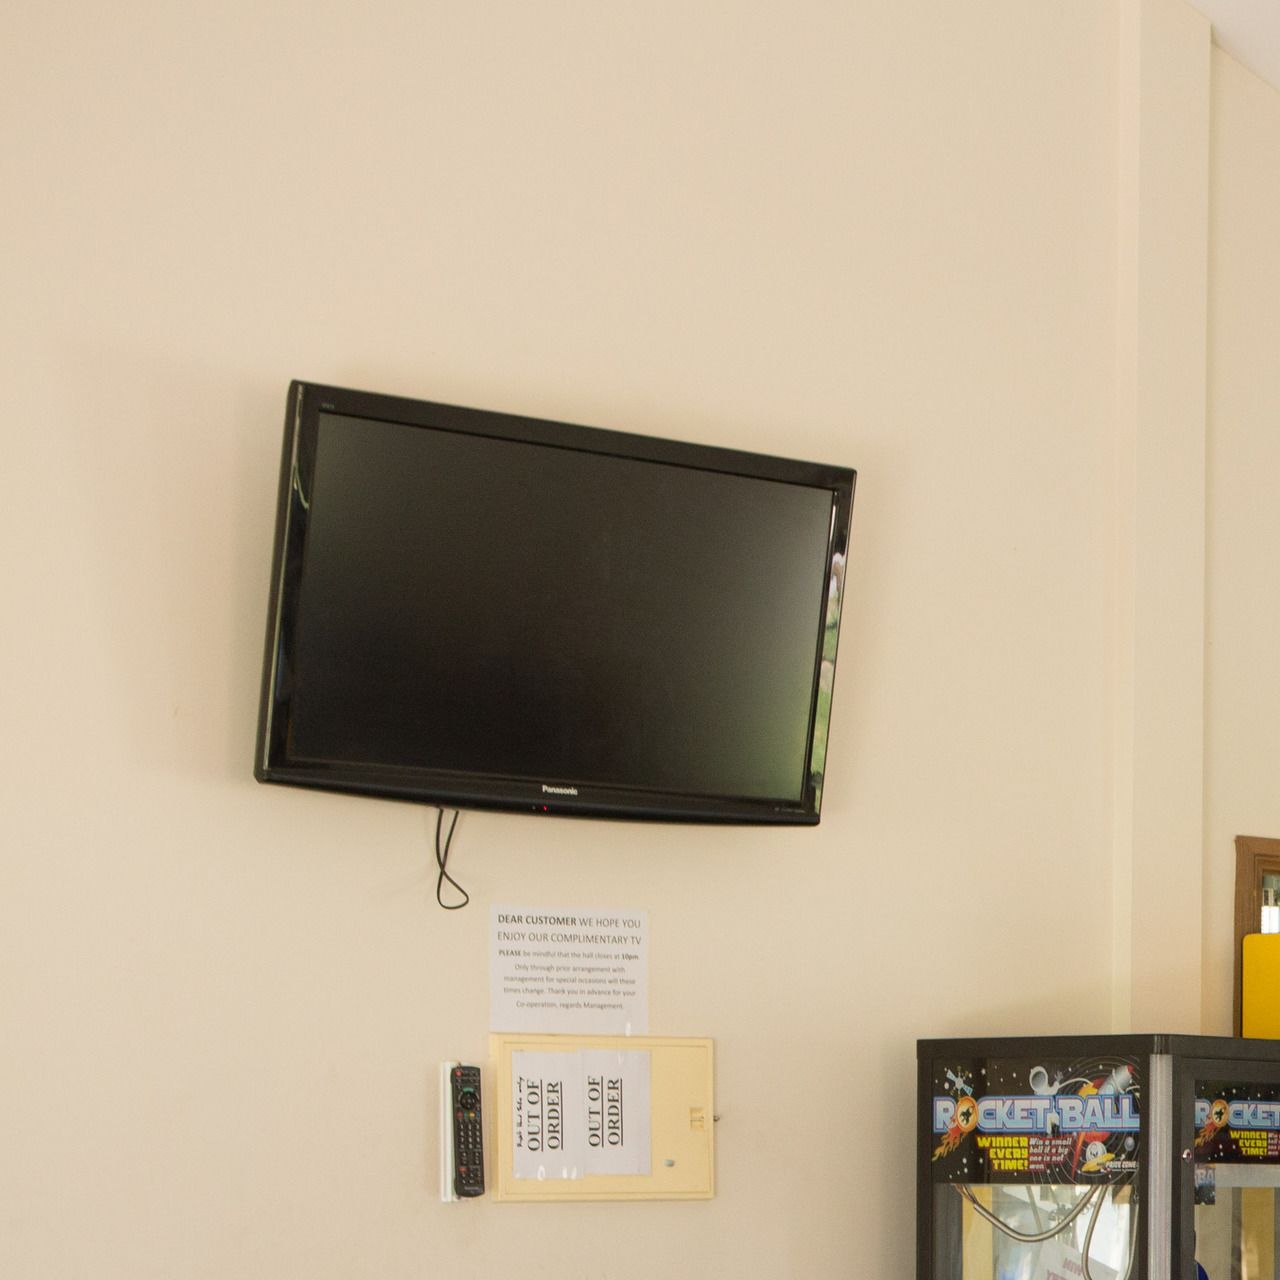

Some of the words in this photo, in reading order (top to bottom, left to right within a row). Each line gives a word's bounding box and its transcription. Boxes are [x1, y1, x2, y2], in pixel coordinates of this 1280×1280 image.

[542, 784, 578, 796] Panasonic
[497, 914, 523, 924] DEAR
[525, 915, 577, 926] CUSTOMER
[578, 917, 594, 927] WE
[596, 917, 620, 928] HOPE
[622, 919, 641, 928] YOU
[497, 931, 526, 941] ENJOY
[528, 932, 548, 942] OUR
[550, 933, 629, 944] COMPLIMENTARY
[630, 935, 642, 944] TV
[527, 1079, 540, 1105] OF
[587, 1075, 601, 1101] OF
[546, 1081, 560, 1149] ORDER
[607, 1078, 621, 1146] ORDER
[933, 1095, 1054, 1133] ROCKET
[1055, 1094, 1140, 1132] BALL
[527, 1111, 541, 1151] OUT
[587, 1107, 601, 1147] OUT
[1029, 1137, 1044, 1145] Win
[1230, 1130, 1267, 1139] WINNER
[977, 1136, 1029, 1148] WINNER
[1239, 1139, 1267, 1147] EVERY
[989, 1148, 1029, 1159] EVERY
[1241, 1147, 1267, 1156] TIME!
[992, 1159, 1029, 1170] TIME!
